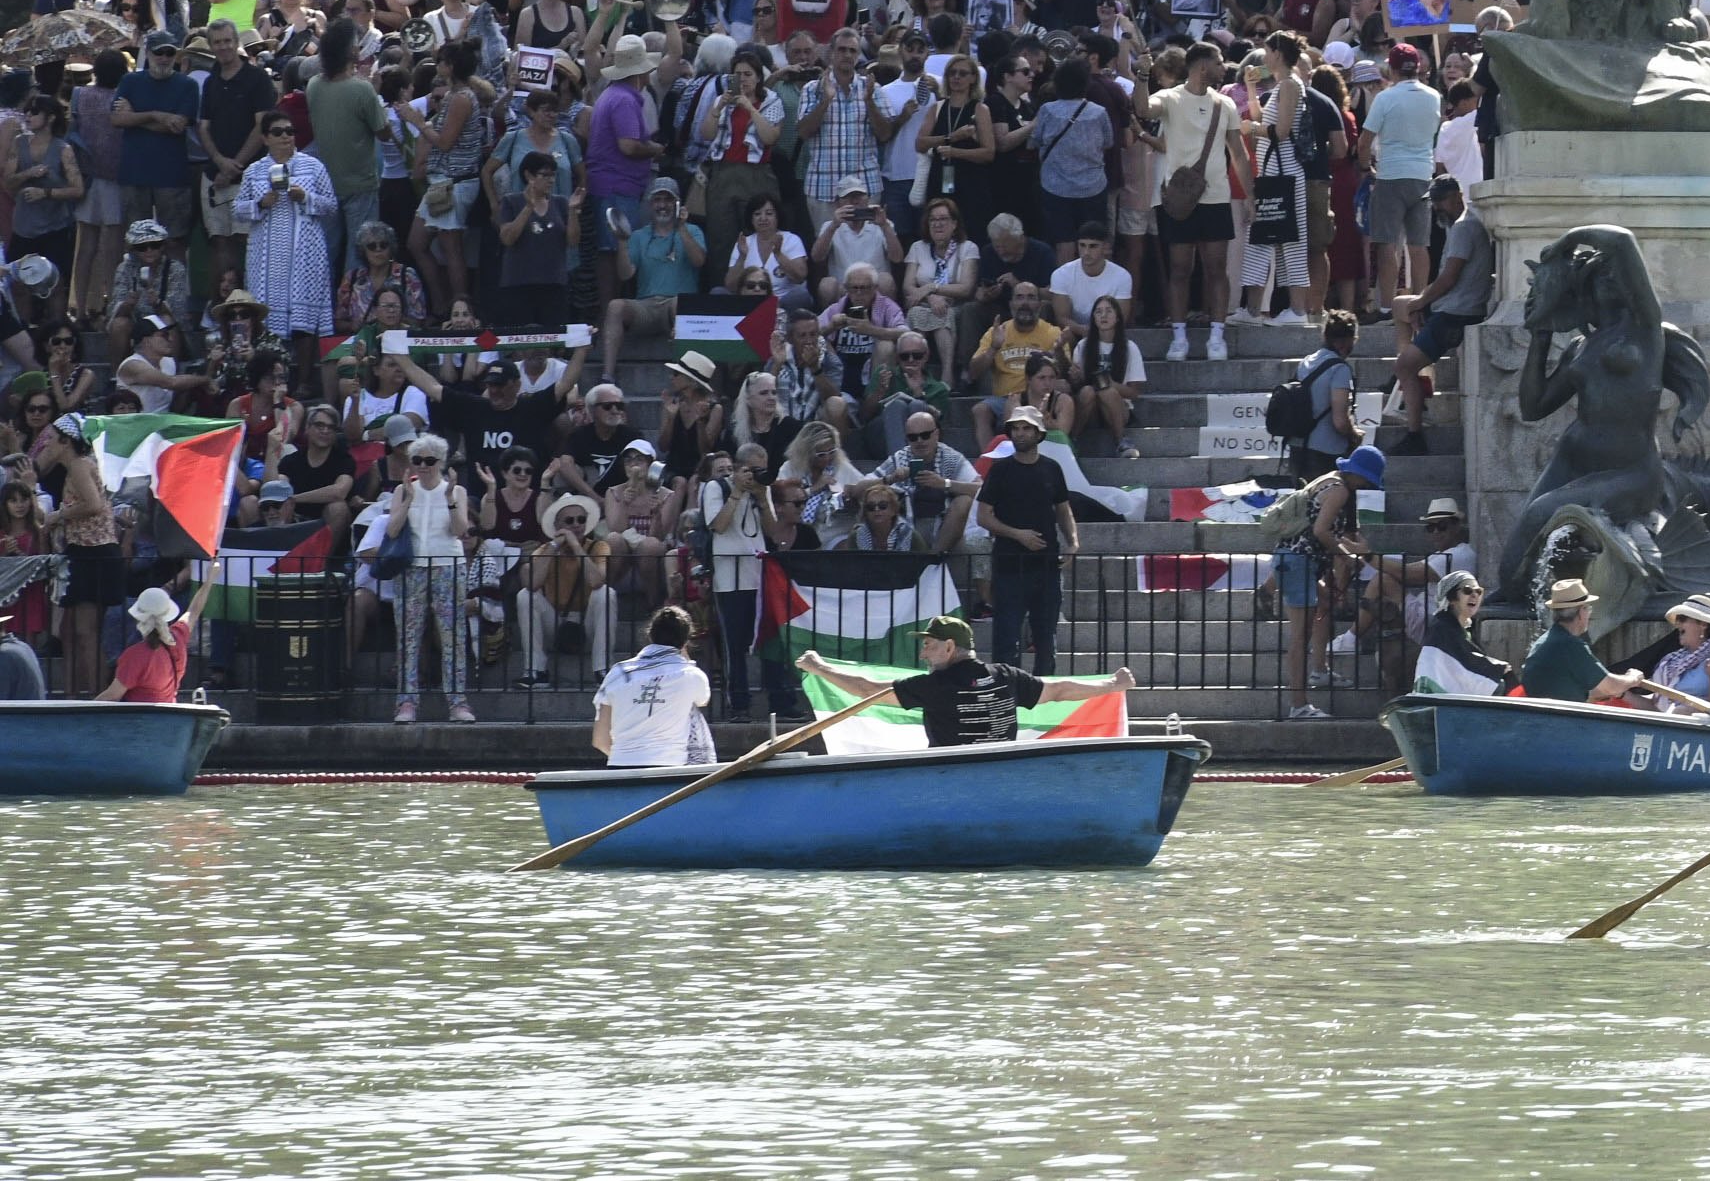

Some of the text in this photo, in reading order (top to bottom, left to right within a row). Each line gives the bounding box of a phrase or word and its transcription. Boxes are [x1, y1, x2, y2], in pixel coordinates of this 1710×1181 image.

[521, 57, 547, 69] SOS
[519, 69, 546, 81] GAZA
[414, 333, 559, 346] PALESTINE PALESTINE
[838, 326, 874, 346] FRE
[482, 431, 513, 449] NO
[1213, 437, 1239, 449] NO
